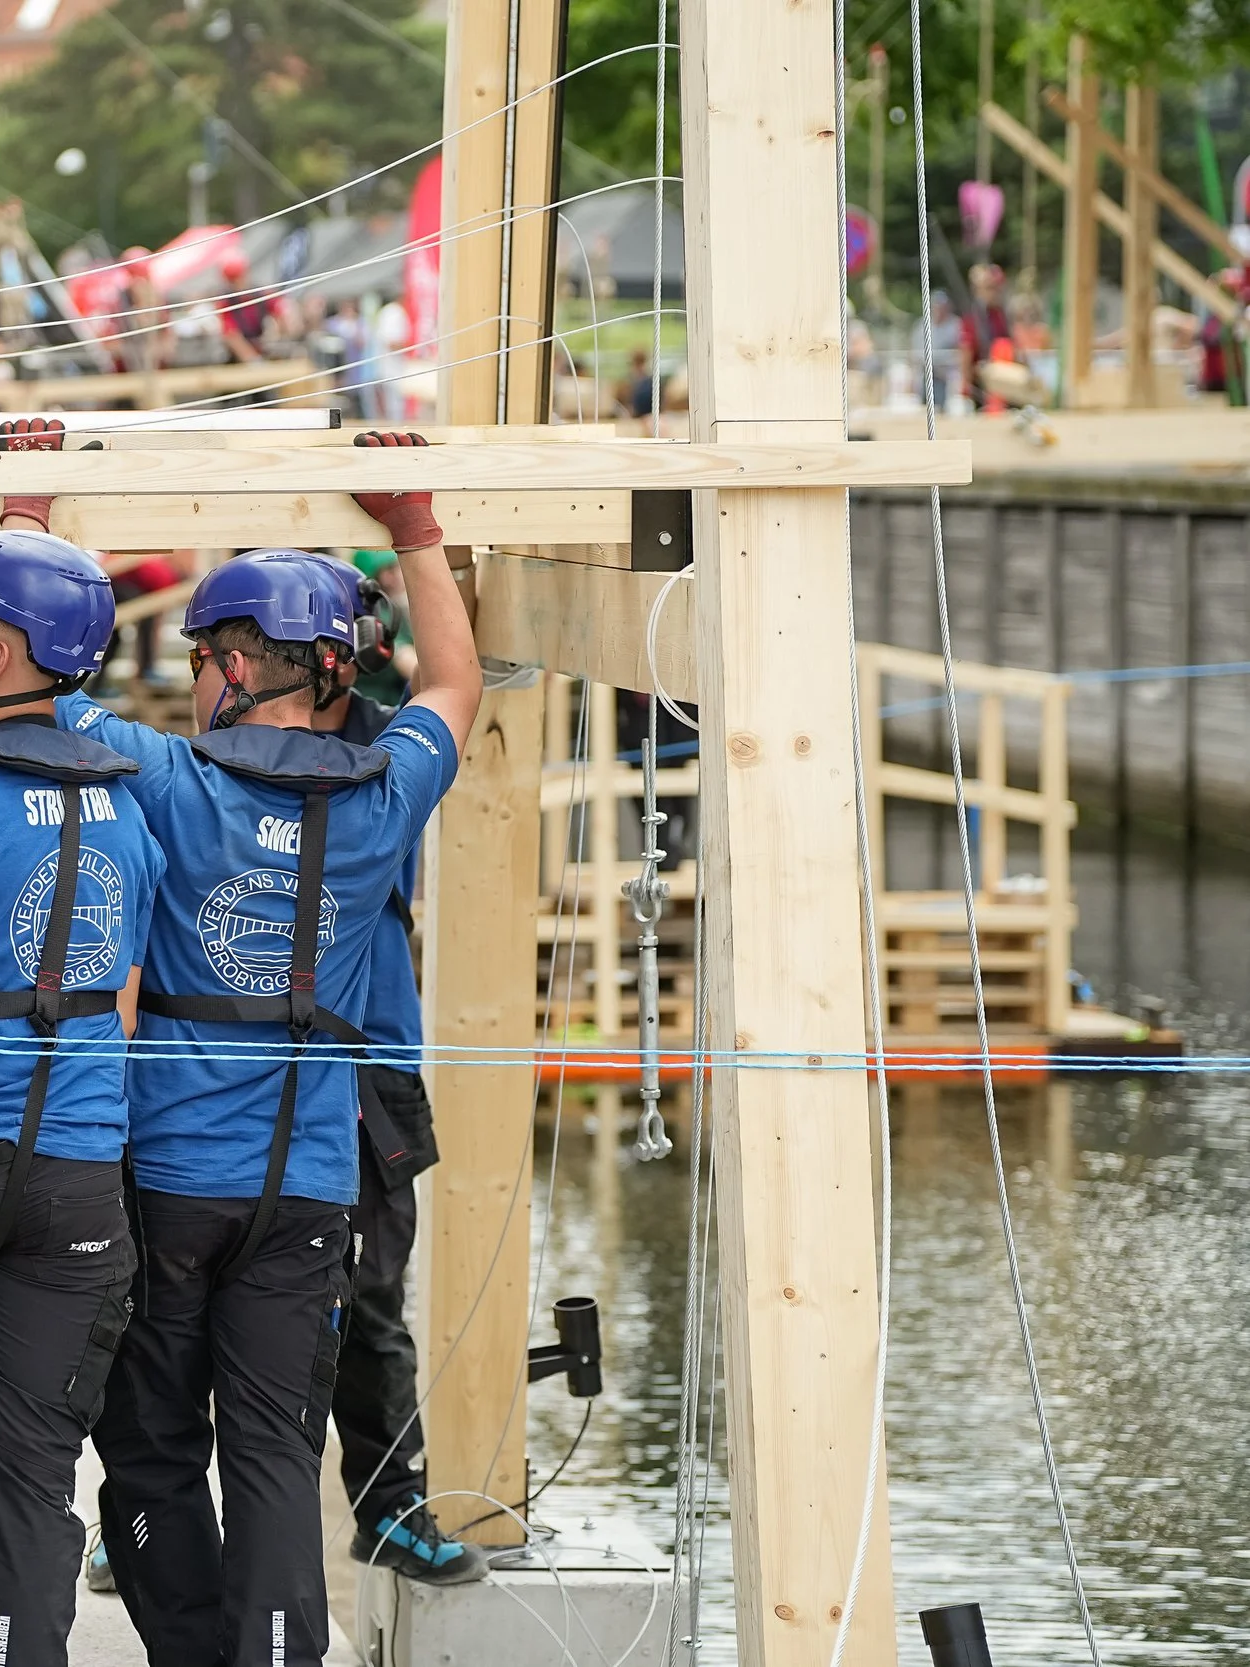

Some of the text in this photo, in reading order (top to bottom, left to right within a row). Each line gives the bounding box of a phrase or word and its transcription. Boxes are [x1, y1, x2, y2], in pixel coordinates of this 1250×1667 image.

[22, 786, 118, 827] STRUTØR
[15, 856, 60, 936] VERDEN
[202, 873, 274, 933] VERDENS
[207, 940, 291, 992] BROBYGG
[272, 1610, 285, 1648] VERDENS
